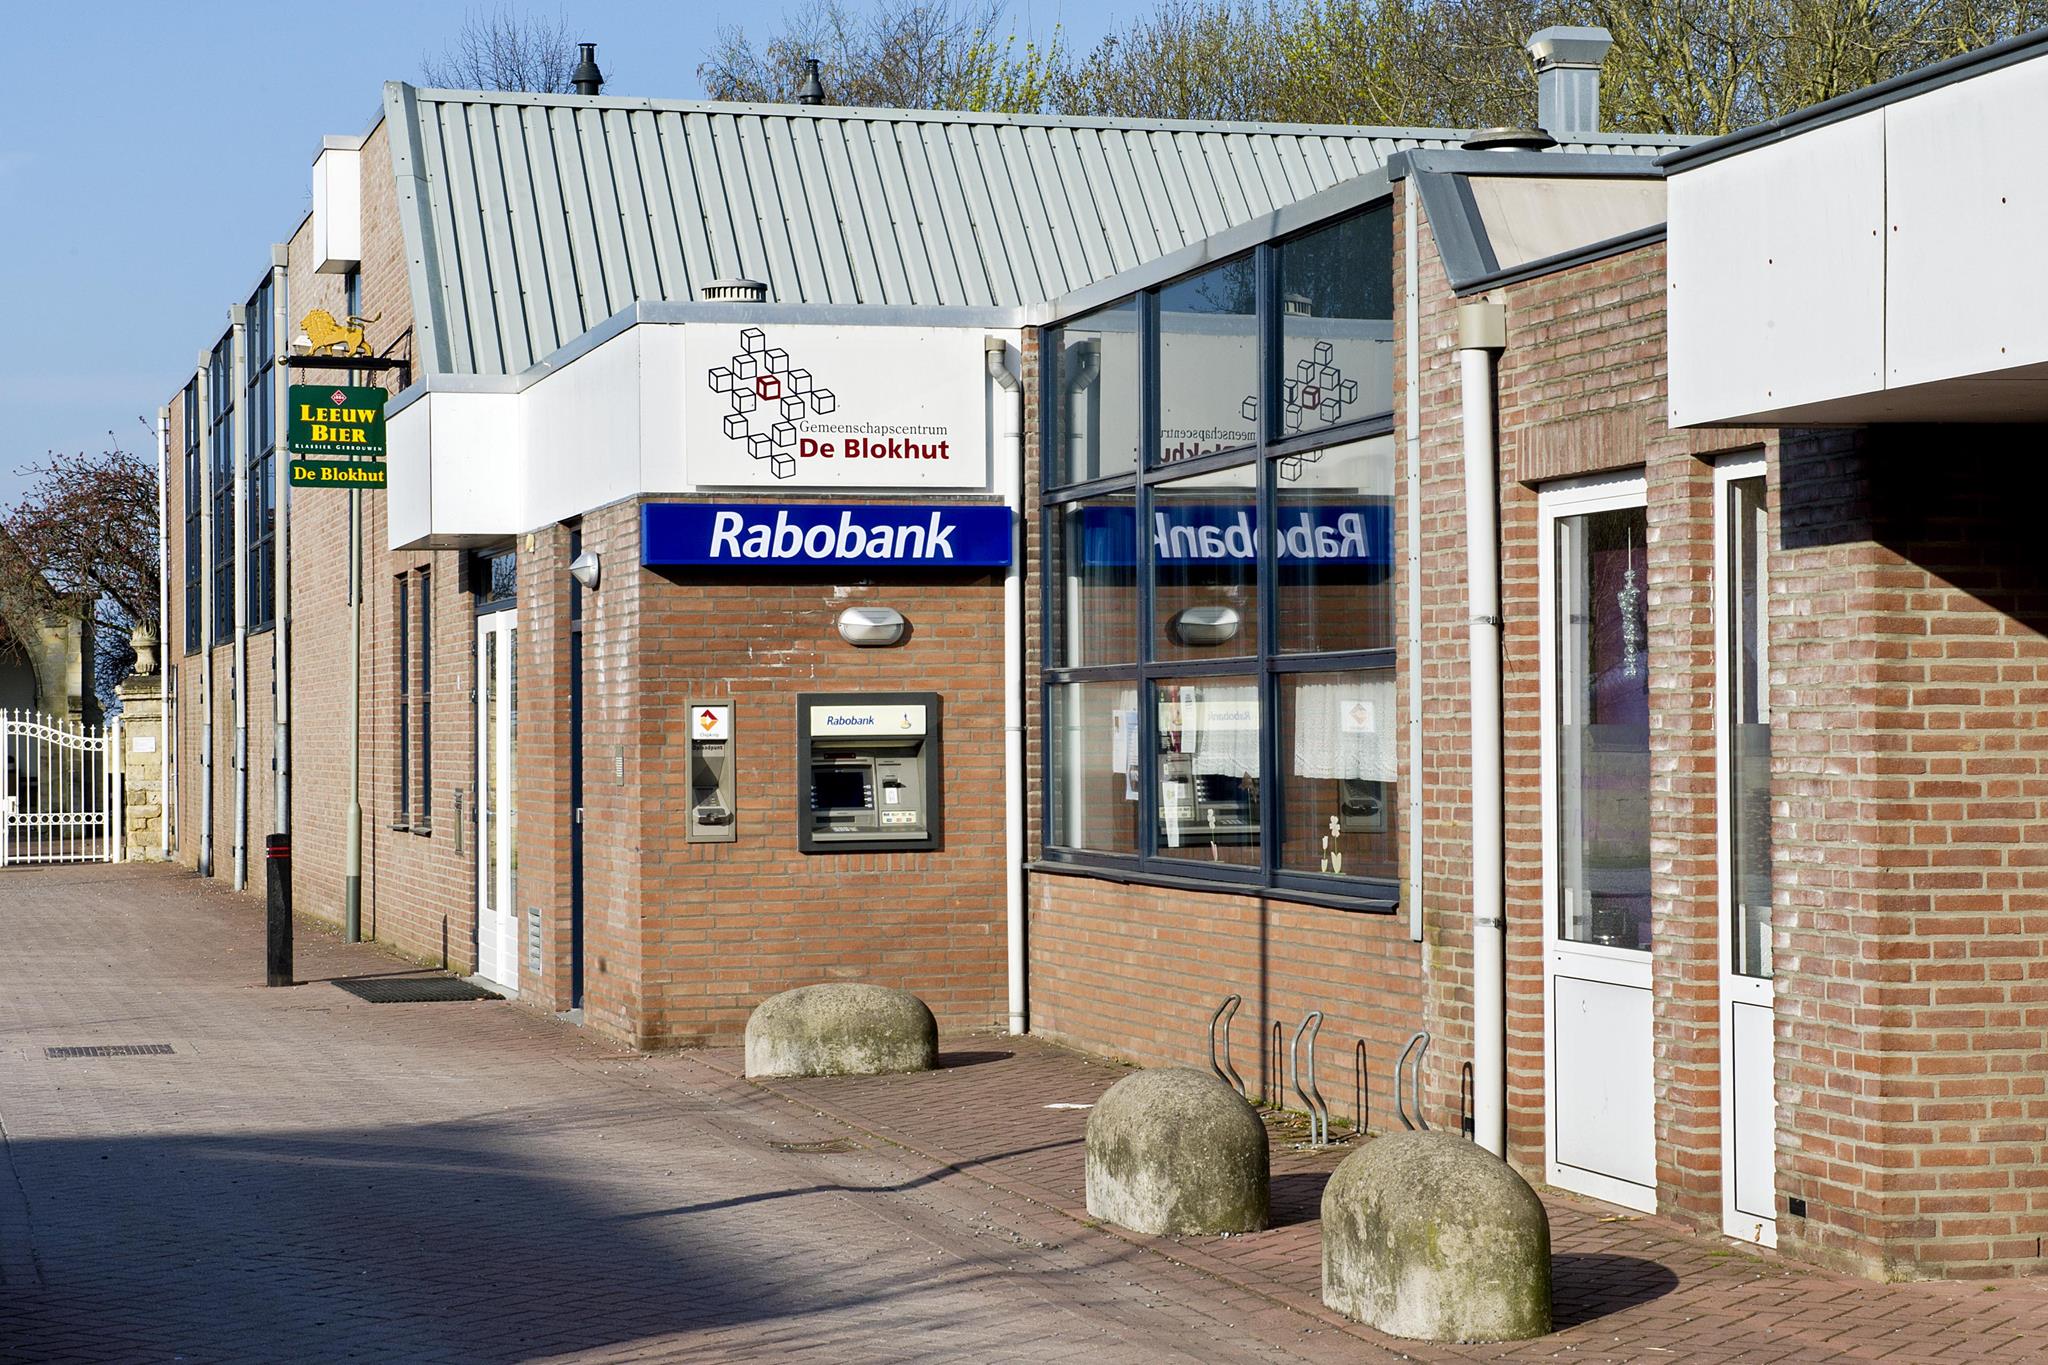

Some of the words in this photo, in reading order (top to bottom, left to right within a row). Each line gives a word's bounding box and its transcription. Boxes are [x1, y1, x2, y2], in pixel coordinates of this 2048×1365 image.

[300, 404, 376, 423] LEEUW
[311, 424, 367, 443] BIER
[799, 420, 948, 436] Gemeenschapscentrum
[799, 438, 835, 458] De
[844, 437, 949, 459] Blokhut
[293, 466, 316, 480] De
[320, 467, 385, 482] Blokhut
[709, 510, 956, 559] Rabobank
[826, 715, 875, 726] Rabobank
